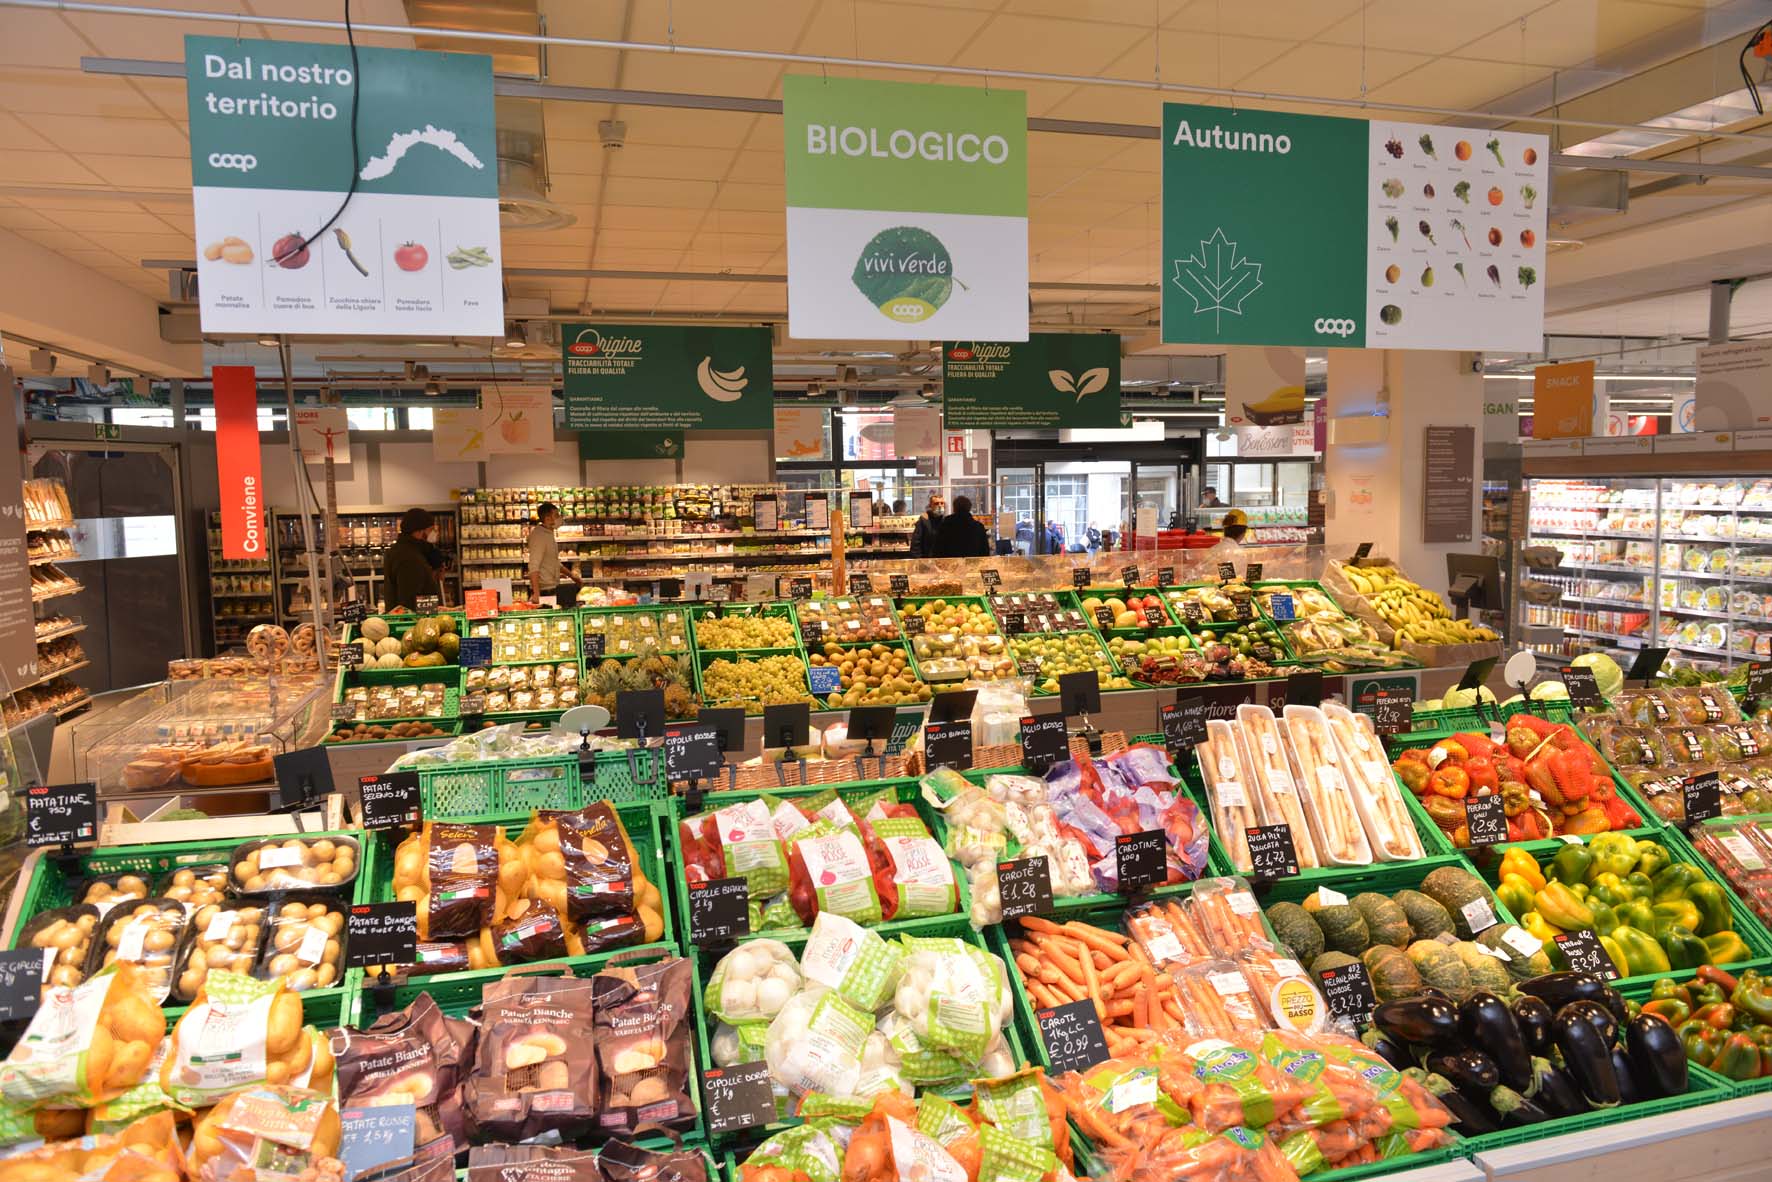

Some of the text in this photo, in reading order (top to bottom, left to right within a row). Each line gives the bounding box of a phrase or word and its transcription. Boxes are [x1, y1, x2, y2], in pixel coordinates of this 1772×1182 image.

[205, 54, 352, 86] Dal nostro
[206, 92, 337, 120] territorio
[807, 124, 1009, 165] BIOLOGICO
[1173, 120, 1291, 154] Autunno
[208, 152, 257, 172] coop
[864, 252, 895, 273] vivi
[892, 303, 924, 318] coop
[1314, 317, 1356, 338] coop
[1483, 403, 1514, 415] EGAN
[241, 475, 258, 553] Conviene
[362, 782, 393, 793] PATATE
[29, 793, 87, 808] PATATINE
[29, 817, 42, 831] €
[1118, 839, 1158, 854] CAROTINE
[1000, 867, 1034, 882] CAROTE
[1281, 994, 1312, 1006] PREZZO
[533, 1008, 574, 1019] Bianche
[1288, 1009, 1313, 1018] BASSO
[611, 1016, 641, 1028] Patate
[1040, 1013, 1077, 1030] CAROTE
[359, 1055, 393, 1073] Patate
[706, 1075, 742, 1090] CIPOLLE
